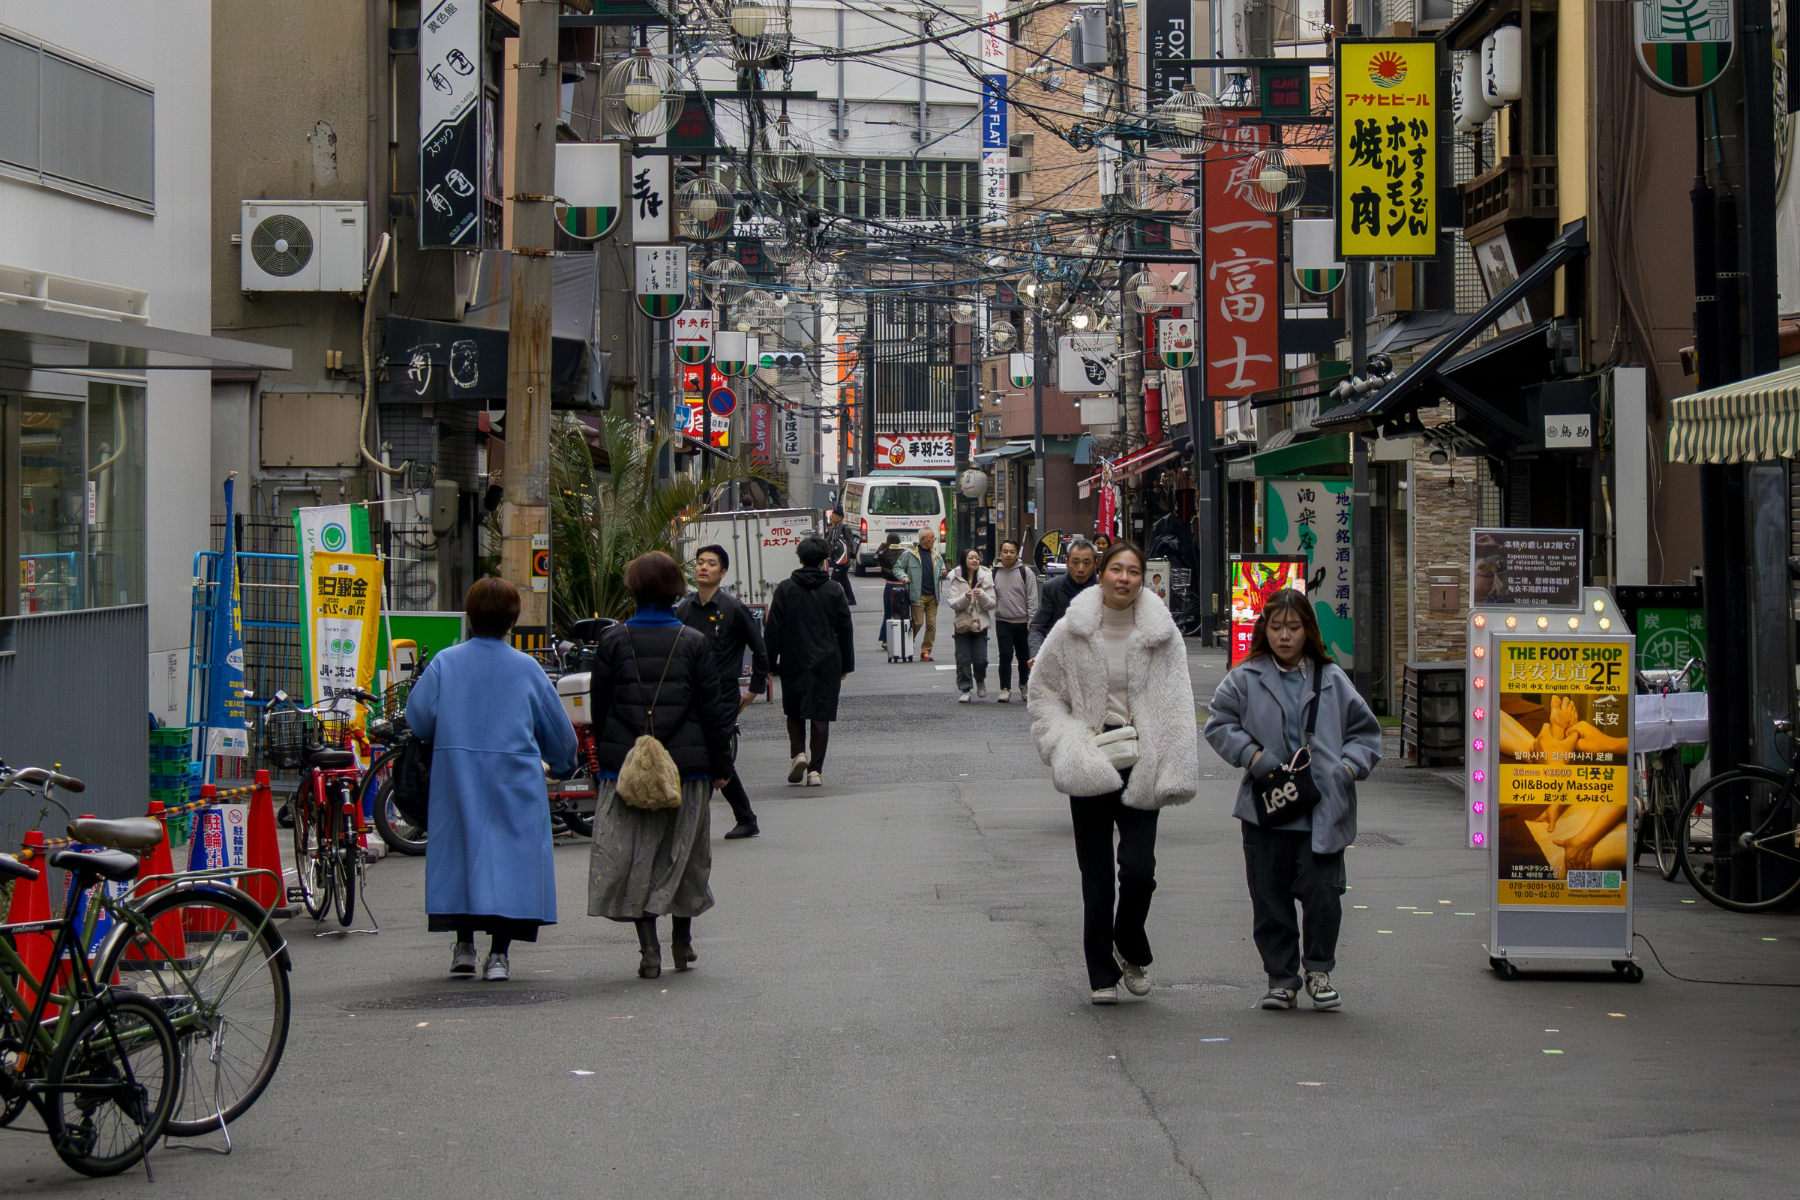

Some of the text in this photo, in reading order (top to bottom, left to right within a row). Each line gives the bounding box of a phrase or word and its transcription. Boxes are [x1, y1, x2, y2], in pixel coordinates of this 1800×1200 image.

[1345, 93, 1430, 107] アサヒビール
[990, 114, 1000, 146] FLAT
[427, 128, 454, 157] スナック
[1348, 117, 1383, 237] 焼肉
[1386, 116, 1407, 237] ホルモン
[1408, 117, 1428, 237] かすうどん
[1508, 647, 1622, 661] THE FOOT SHOP
[1508, 662, 1588, 681] 長安足道
[1590, 662, 1622, 685] 2F
[1508, 682, 1527, 690] 한국어
[1593, 712, 1619, 725] 長安
[1514, 751, 1548, 760] 발마사지
[1577, 767, 1615, 780] 더풋샵
[1512, 779, 1614, 793] Oil&Body Massage
[1262, 781, 1299, 814] Lee
[1512, 793, 1613, 802] オイル 足ツボ もみほぐし
[233, 826, 243, 866] 駐輪禁止
[1509, 882, 1564, 890] 070-9001-1502
